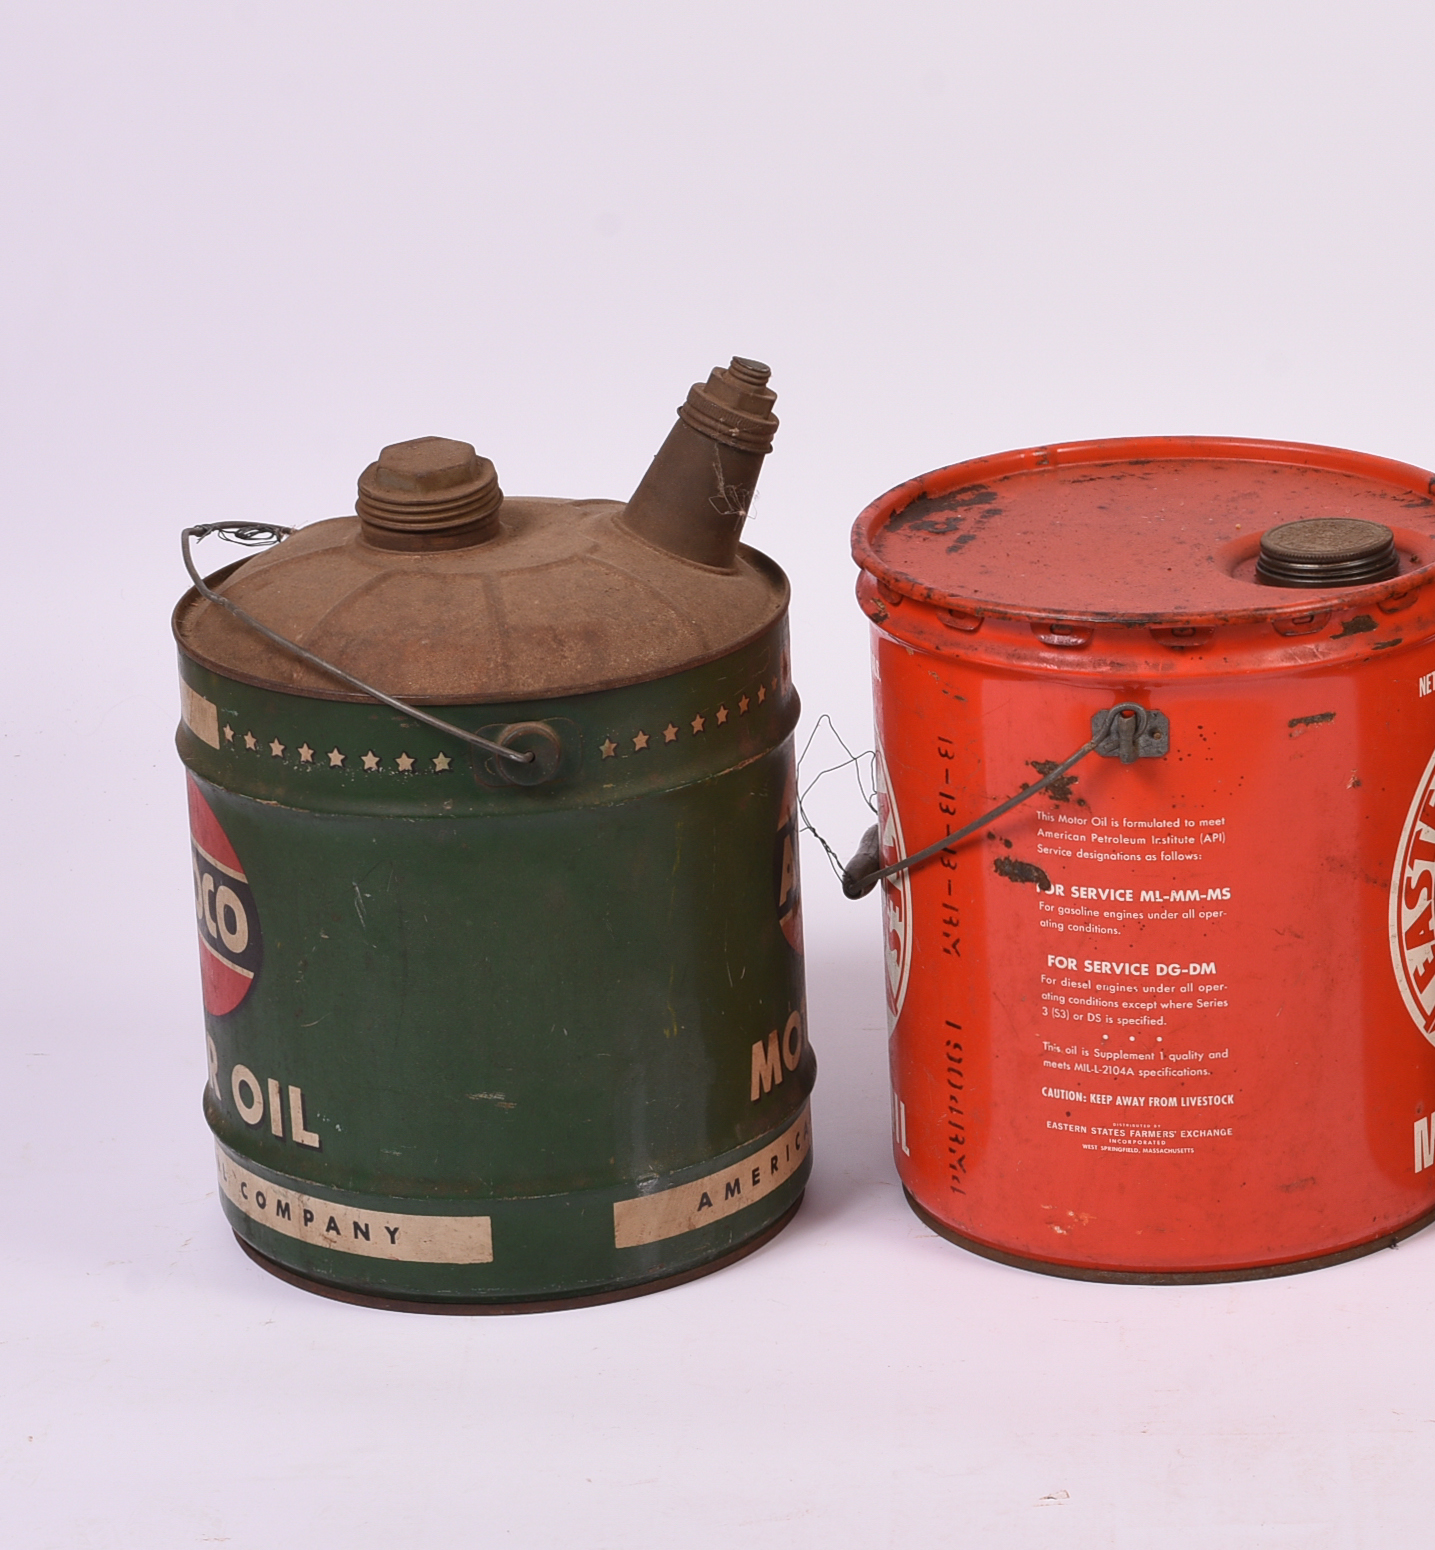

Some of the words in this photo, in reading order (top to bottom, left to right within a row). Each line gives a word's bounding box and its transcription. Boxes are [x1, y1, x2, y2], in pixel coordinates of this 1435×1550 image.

[1036, 811, 1054, 822] This
[1058, 814, 1087, 826] Motor
[1091, 817, 1107, 827] Oil
[1111, 817, 1119, 827] is
[1123, 818, 1180, 828] formulated
[1185, 818, 1195, 827] to
[1199, 817, 1225, 827] meet
[1037, 828, 1086, 841] American
[1091, 833, 1146, 844] Petroleum
[1200, 832, 1226, 844] (API)
[1037, 844, 1071, 857] Service
[1077, 849, 1141, 862] designations
[1145, 853, 1157, 861] as
[1160, 851, 1202, 861] follows:
[1071, 886, 1133, 902] SERVICE
[1140, 888, 1231, 902] ML-MM-MS
[1039, 901, 1054, 912] For
[1058, 905, 1099, 917] gasoline
[1103, 910, 1144, 920] engines
[1148, 910, 1178, 919] under
[1182, 909, 1195, 918] all
[1199, 910, 1227, 920] oper-
[1040, 920, 1064, 931] ating
[1068, 923, 1121, 935] conditions.
[1048, 955, 1077, 970] FOR
[1084, 960, 1149, 975] SERVICE
[1156, 962, 1216, 976] DG-DM
[1041, 974, 1056, 985] For
[1061, 978, 1091, 989] diesel
[1096, 983, 1138, 994] engines
[1142, 983, 1175, 992] under
[1180, 983, 1193, 992] all
[1198, 984, 1228, 994] oper-
[1041, 993, 1065, 1004] ating
[1069, 996, 1118, 1008] conditions
[1122, 1001, 1157, 1011] except
[1161, 1000, 1192, 1008] where
[1196, 999, 1228, 1008] Series
[1042, 1006, 1048, 1016] 3
[1052, 1008, 1069, 1020] (S3)
[1087, 1013, 1101, 1023] DS
[1105, 1015, 1113, 1024] is
[1117, 1016, 1167, 1026] specified.
[1043, 1042, 1060, 1053] This
[1065, 1046, 1077, 1054] oil
[1082, 1048, 1089, 1057] is
[1094, 1049, 1155, 1060] Supplement
[1169, 1050, 1203, 1062] quality
[1208, 1049, 1228, 1059] and
[1043, 1059, 1071, 1071] meets
[1074, 1064, 1134, 1075] MIL-L-2104A
[1138, 1067, 1211, 1078] specifications.
[231, 1064, 320, 1148] OIL
[1042, 1087, 1087, 1102] CAUTION:
[1090, 1093, 1112, 1104] KEEP
[1116, 1095, 1145, 1106] AWAY
[1149, 1097, 1177, 1106] FROM
[1181, 1095, 1234, 1106] LIVESTOCK
[1047, 1121, 1087, 1133] EASTERN
[1091, 1127, 1125, 1136] STATES
[1181, 1128, 1233, 1137] EXCHANGE
[240, 1182, 400, 1245] COMPANY
